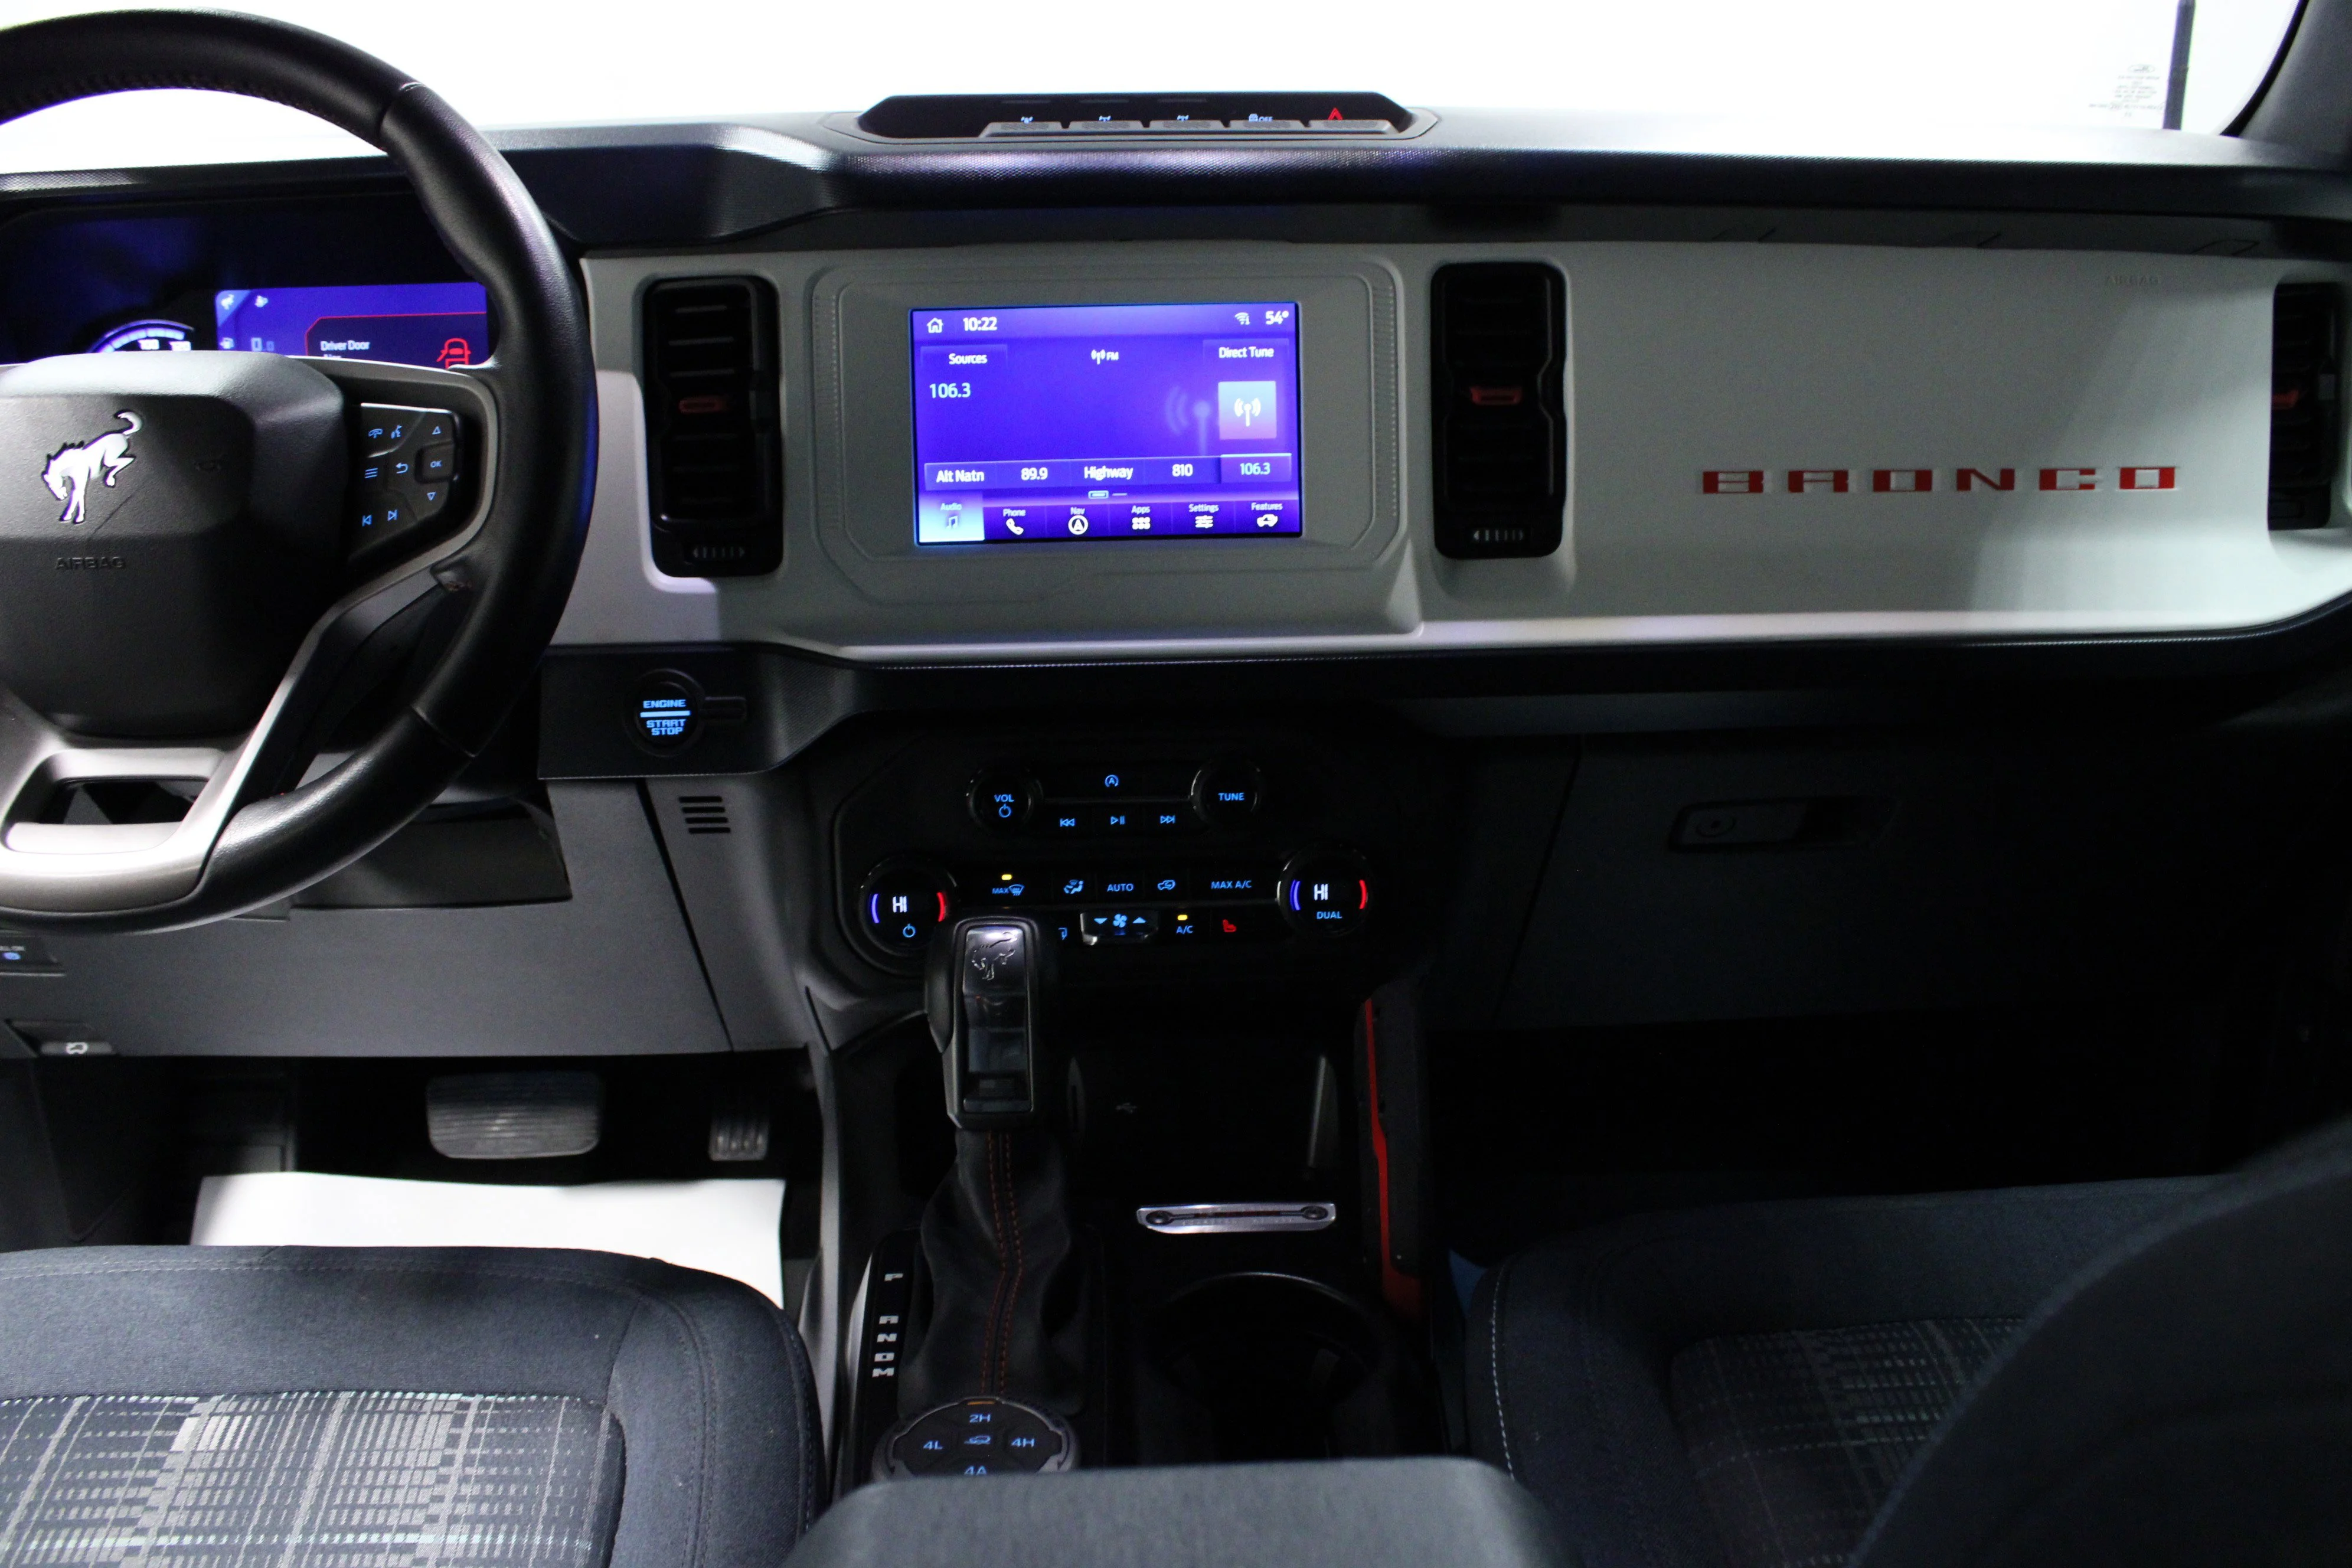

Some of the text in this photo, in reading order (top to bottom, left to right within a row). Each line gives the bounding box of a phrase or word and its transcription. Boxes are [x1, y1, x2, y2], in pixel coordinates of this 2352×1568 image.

[963, 316, 998, 331] 10:22
[321, 339, 371, 351] Driver Door
[1106, 352, 1119, 361] FM
[1219, 346, 1275, 358] Direct Tune
[948, 352, 988, 365] Sources
[929, 382, 971, 398] 106.3
[430, 460, 442, 468] OK
[1240, 462, 1270, 475] 106.3
[1021, 467, 1048, 481] 89.9
[1084, 465, 1133, 481] Highway
[1172, 463, 1193, 477] 810
[936, 469, 985, 483] Alt Natn
[1703, 467, 2175, 494] BRONCO
[940, 502, 962, 511] Audio
[1070, 507, 1085, 515] Nav
[1131, 505, 1151, 515] Apps
[1188, 504, 1220, 513] Settings
[1250, 502, 1283, 511] Features
[1002, 508, 1026, 517] Phone
[55, 556, 126, 570] AIRBAG
[643, 699, 687, 708] ENGINE
[646, 719, 686, 728] START
[651, 727, 683, 736] STOP
[994, 794, 1014, 802] VOL
[1218, 792, 1245, 802] TUNE
[1107, 883, 1134, 892] AUTO
[1211, 880, 1252, 889] MAX A/C
[1314, 884, 1328, 900] HI
[892, 896, 907, 913] HI
[1316, 911, 1342, 919] DUAL
[1176, 925, 1193, 935] A/C
[884, 1273, 903, 1282] P
[877, 1332, 897, 1342] N
[872, 1367, 895, 1377] M
[969, 1414, 991, 1423] 2H
[923, 1440, 943, 1450] 4L
[1011, 1438, 1035, 1447] 4H
[965, 1466, 987, 1475] 4A
